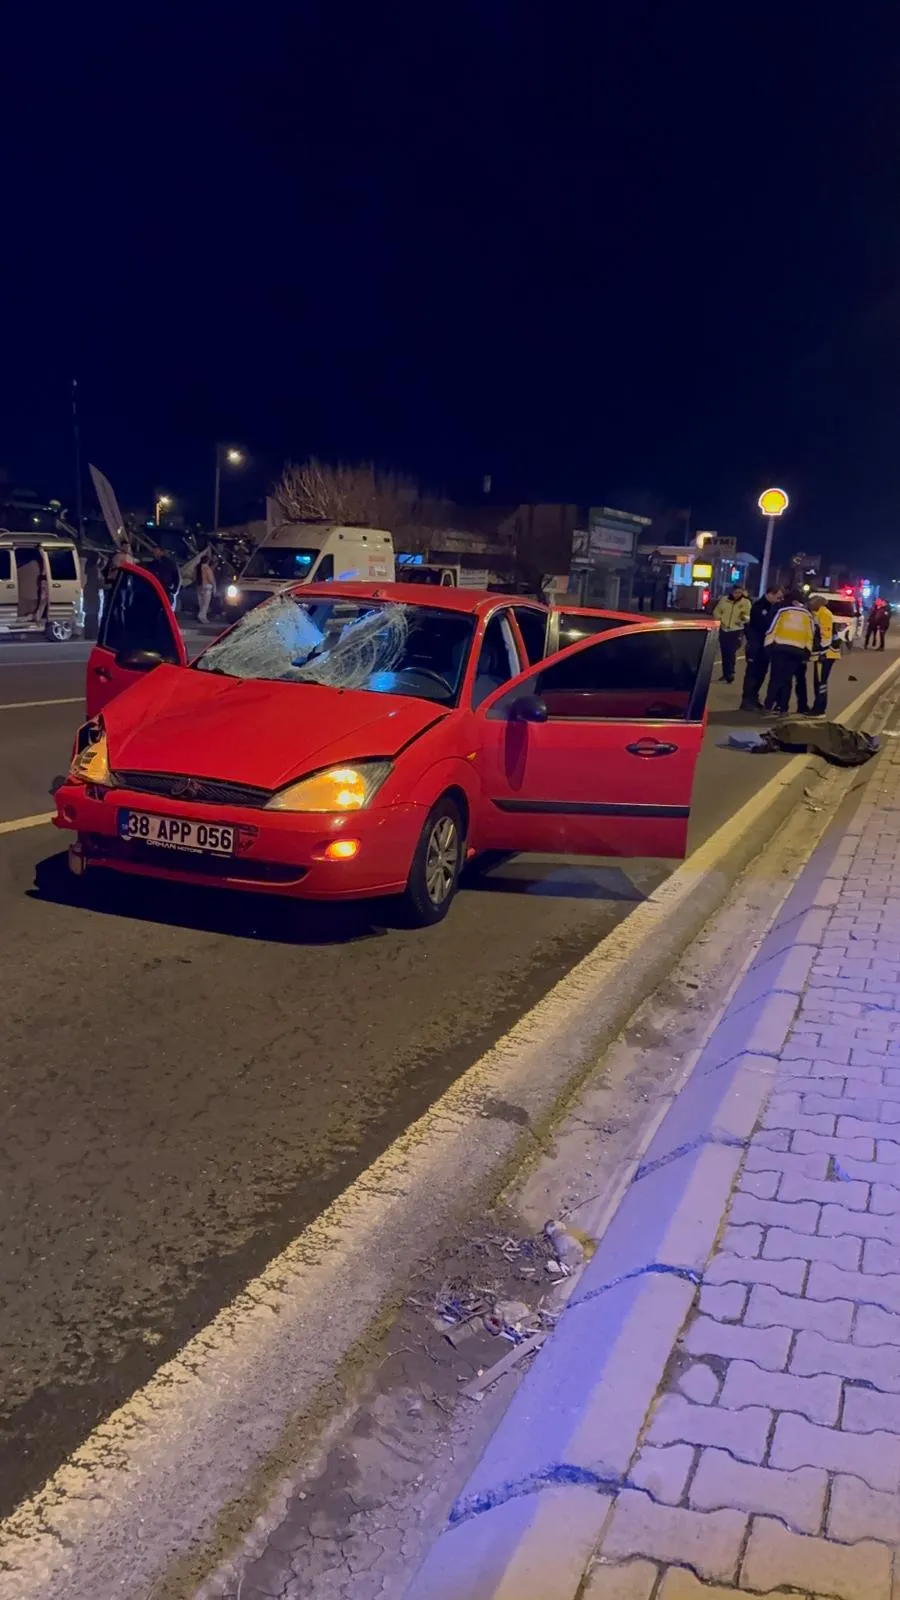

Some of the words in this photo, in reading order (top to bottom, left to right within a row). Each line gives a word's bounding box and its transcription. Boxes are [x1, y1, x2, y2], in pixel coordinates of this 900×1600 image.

[128, 815, 150, 836] 38
[157, 820, 191, 842] APP
[197, 825, 232, 849] 056
[146, 840, 176, 850] ORMAN
